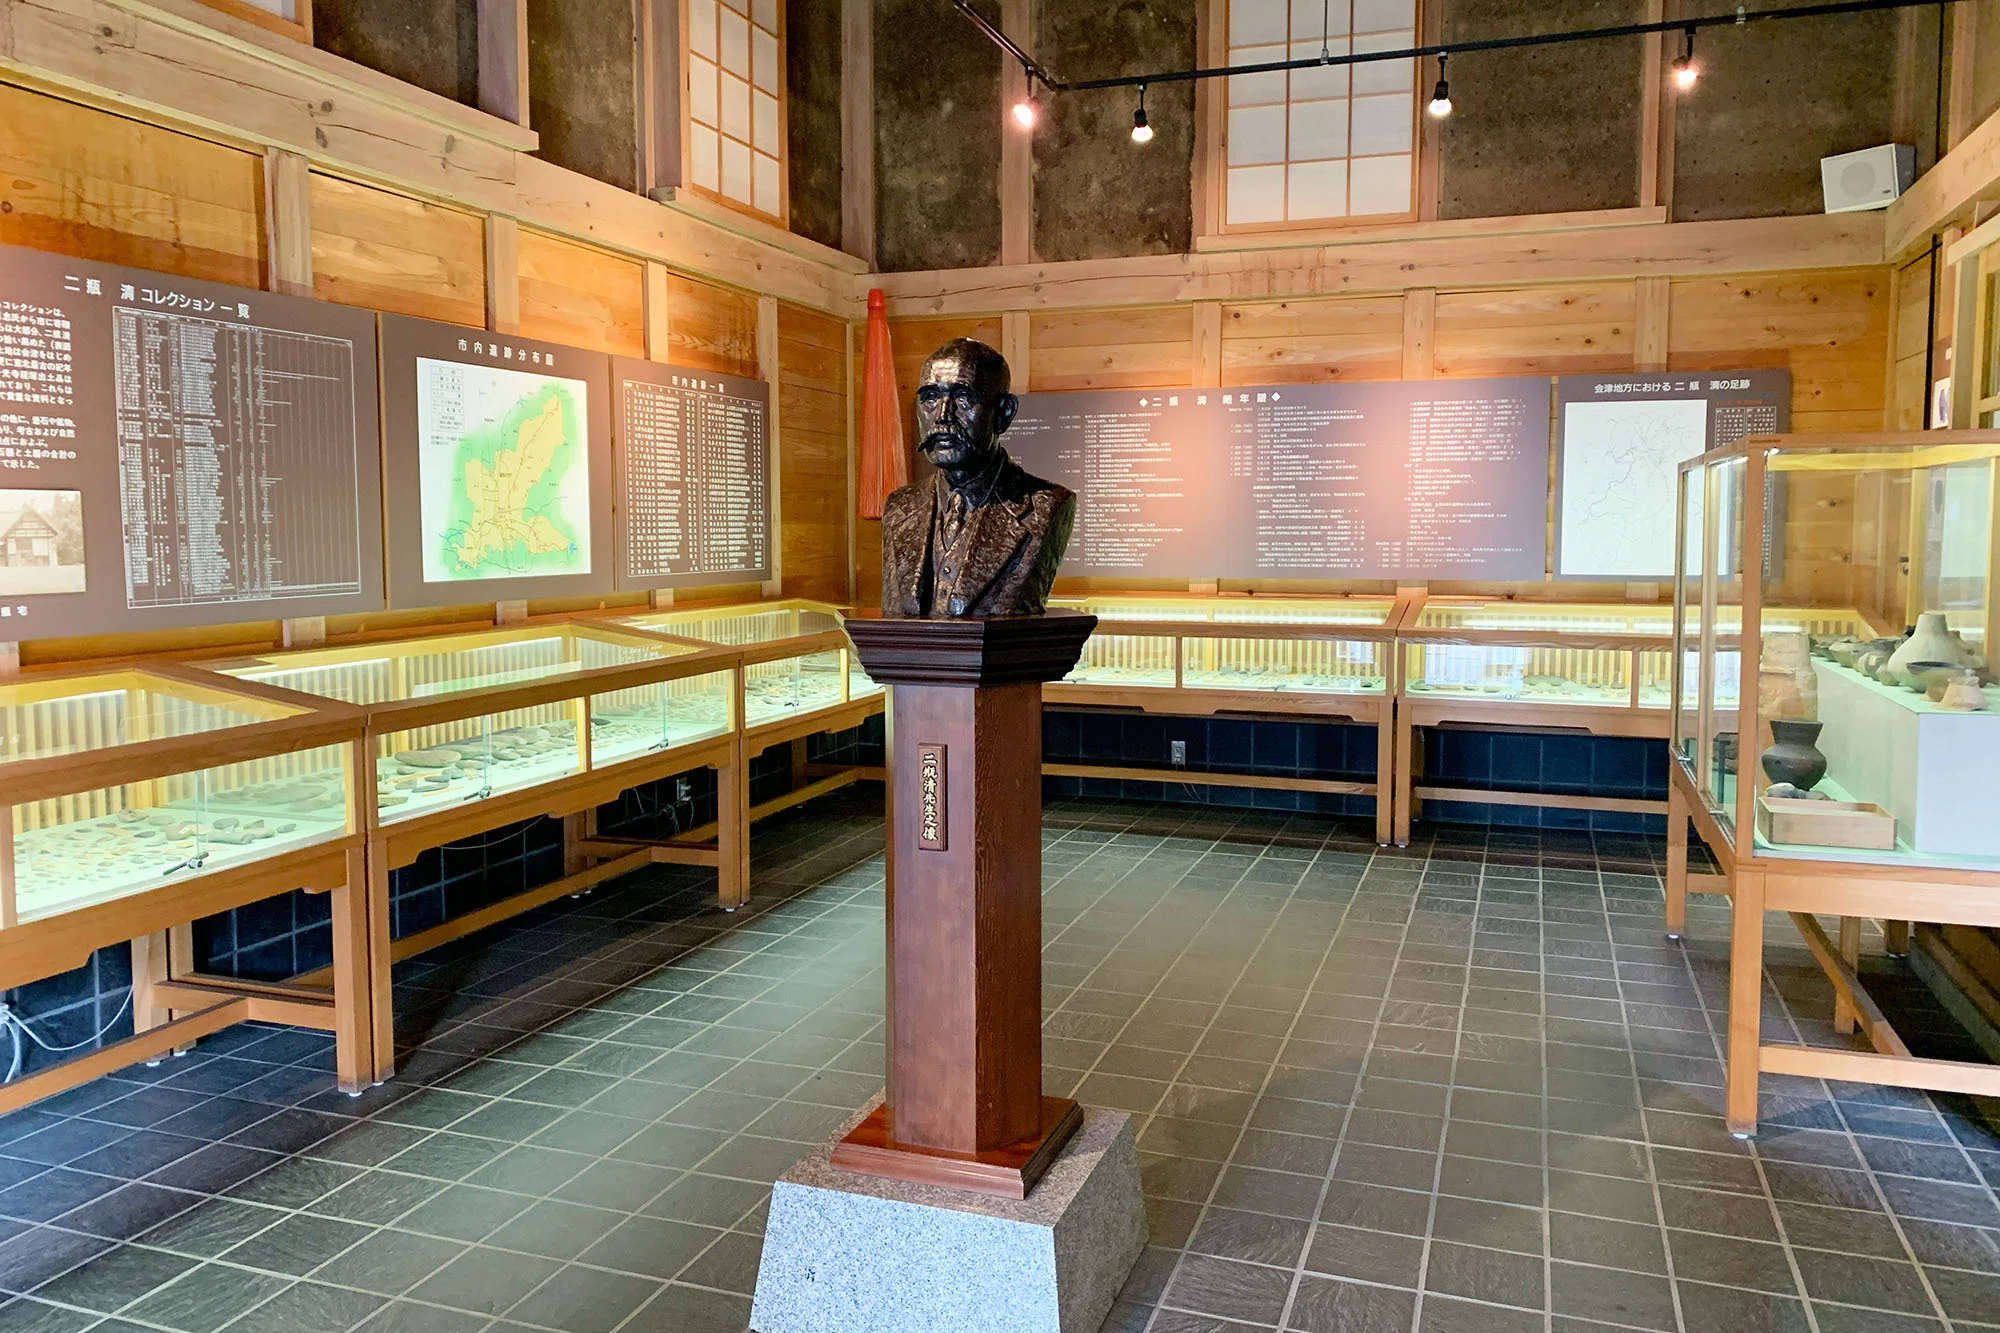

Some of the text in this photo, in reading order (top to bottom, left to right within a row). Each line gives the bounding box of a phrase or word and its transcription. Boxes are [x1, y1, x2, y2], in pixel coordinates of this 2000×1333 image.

[0, 301, 65, 318] コレクションは、
